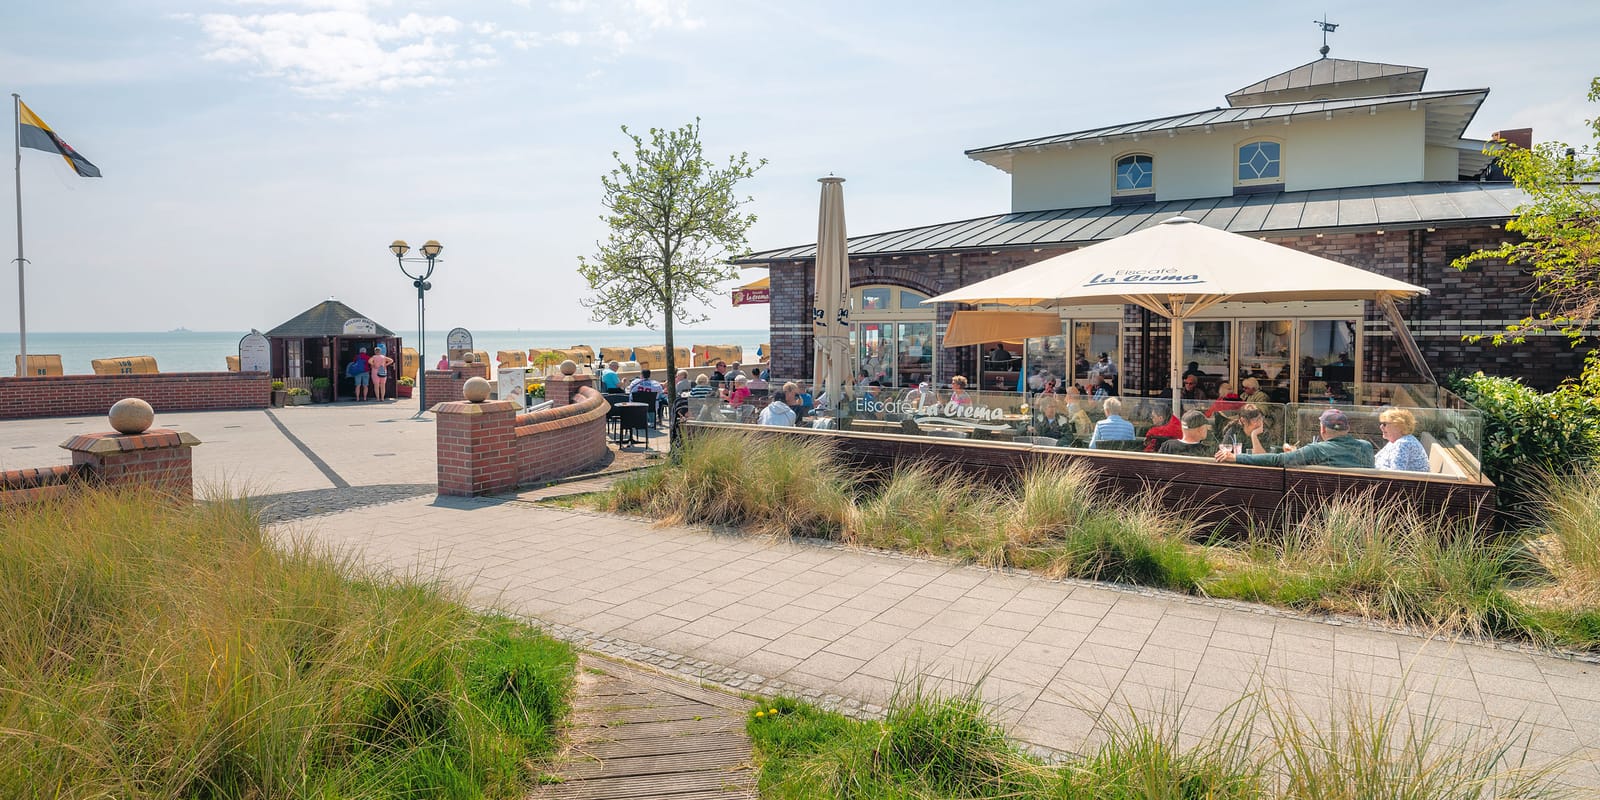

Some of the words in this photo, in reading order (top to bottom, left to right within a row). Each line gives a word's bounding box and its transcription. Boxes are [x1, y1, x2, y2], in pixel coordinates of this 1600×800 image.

[1089, 273, 1116, 284] La
[1123, 274, 1199, 282] Crema
[916, 392, 938, 416] La
[943, 401, 1003, 421] Crema
